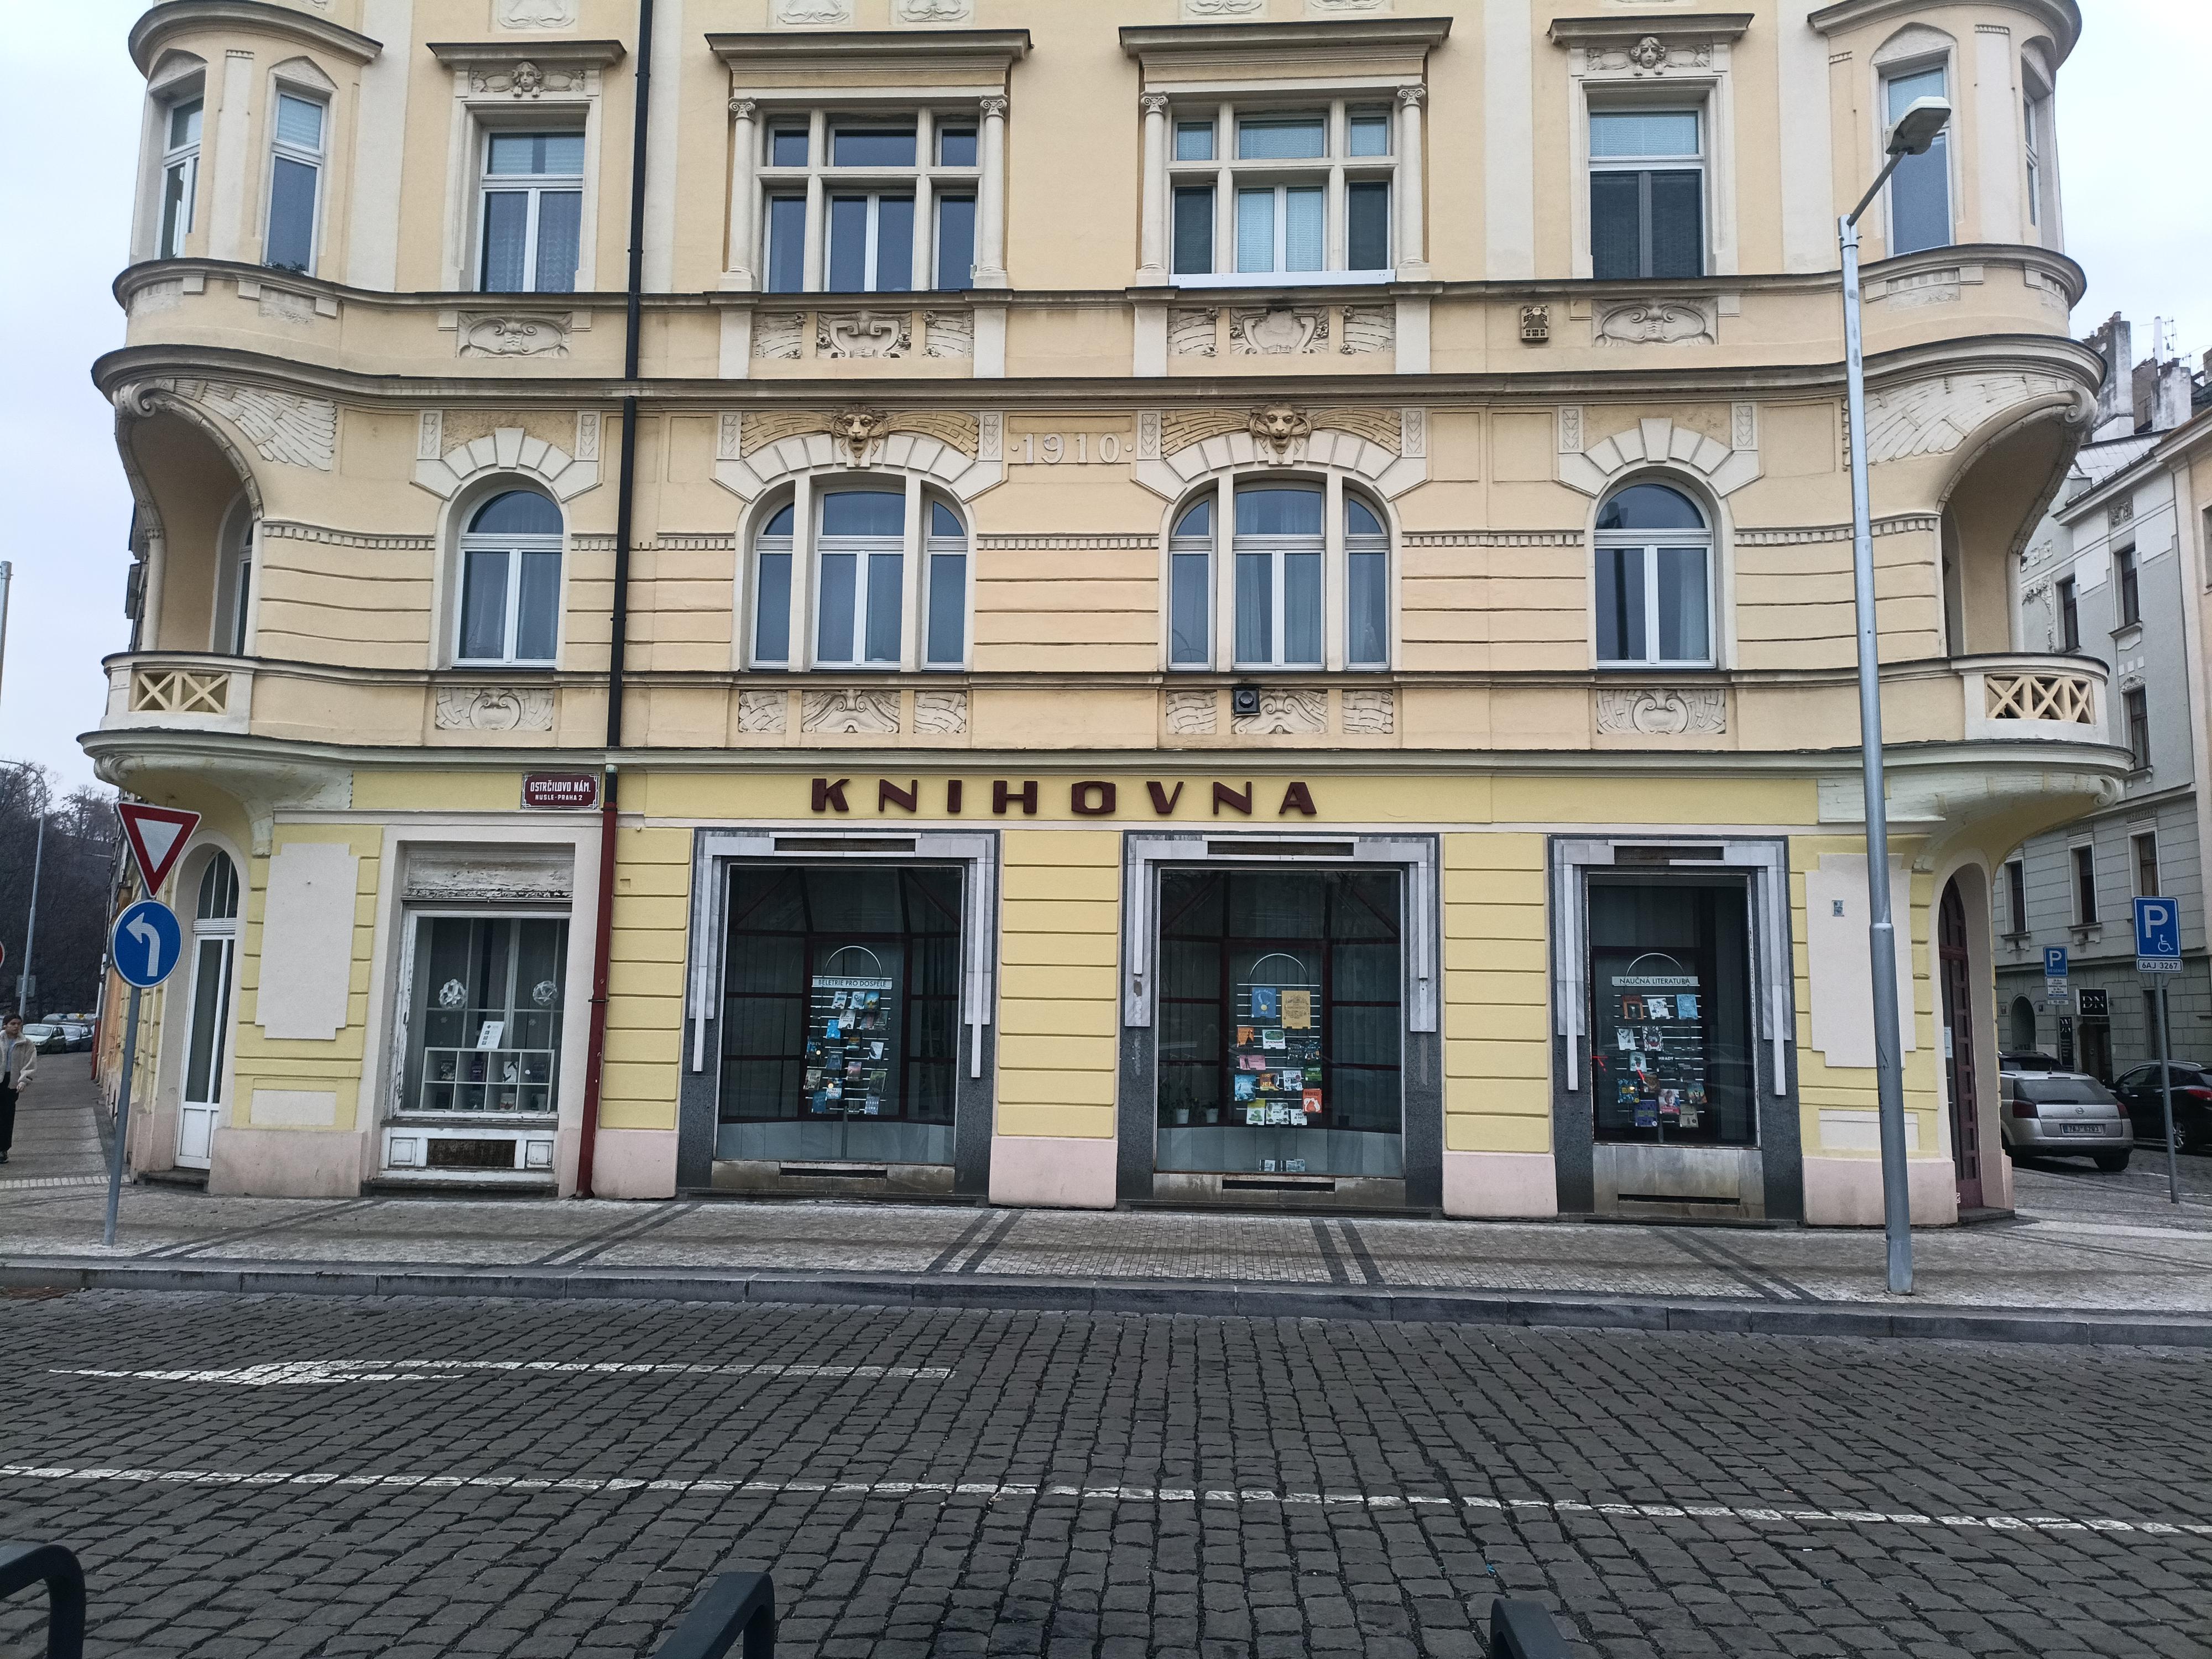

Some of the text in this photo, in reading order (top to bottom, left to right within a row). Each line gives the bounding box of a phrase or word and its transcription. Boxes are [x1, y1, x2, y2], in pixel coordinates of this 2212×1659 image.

[1023, 432, 1120, 464] 1910
[530, 779, 591, 792] OSTRČILOVO NÁM.
[811, 777, 1318, 815] KNIHOVNA
[2143, 905, 2168, 938] P
[2049, 950, 2062, 967] P
[2159, 962, 2178, 970] 3267
